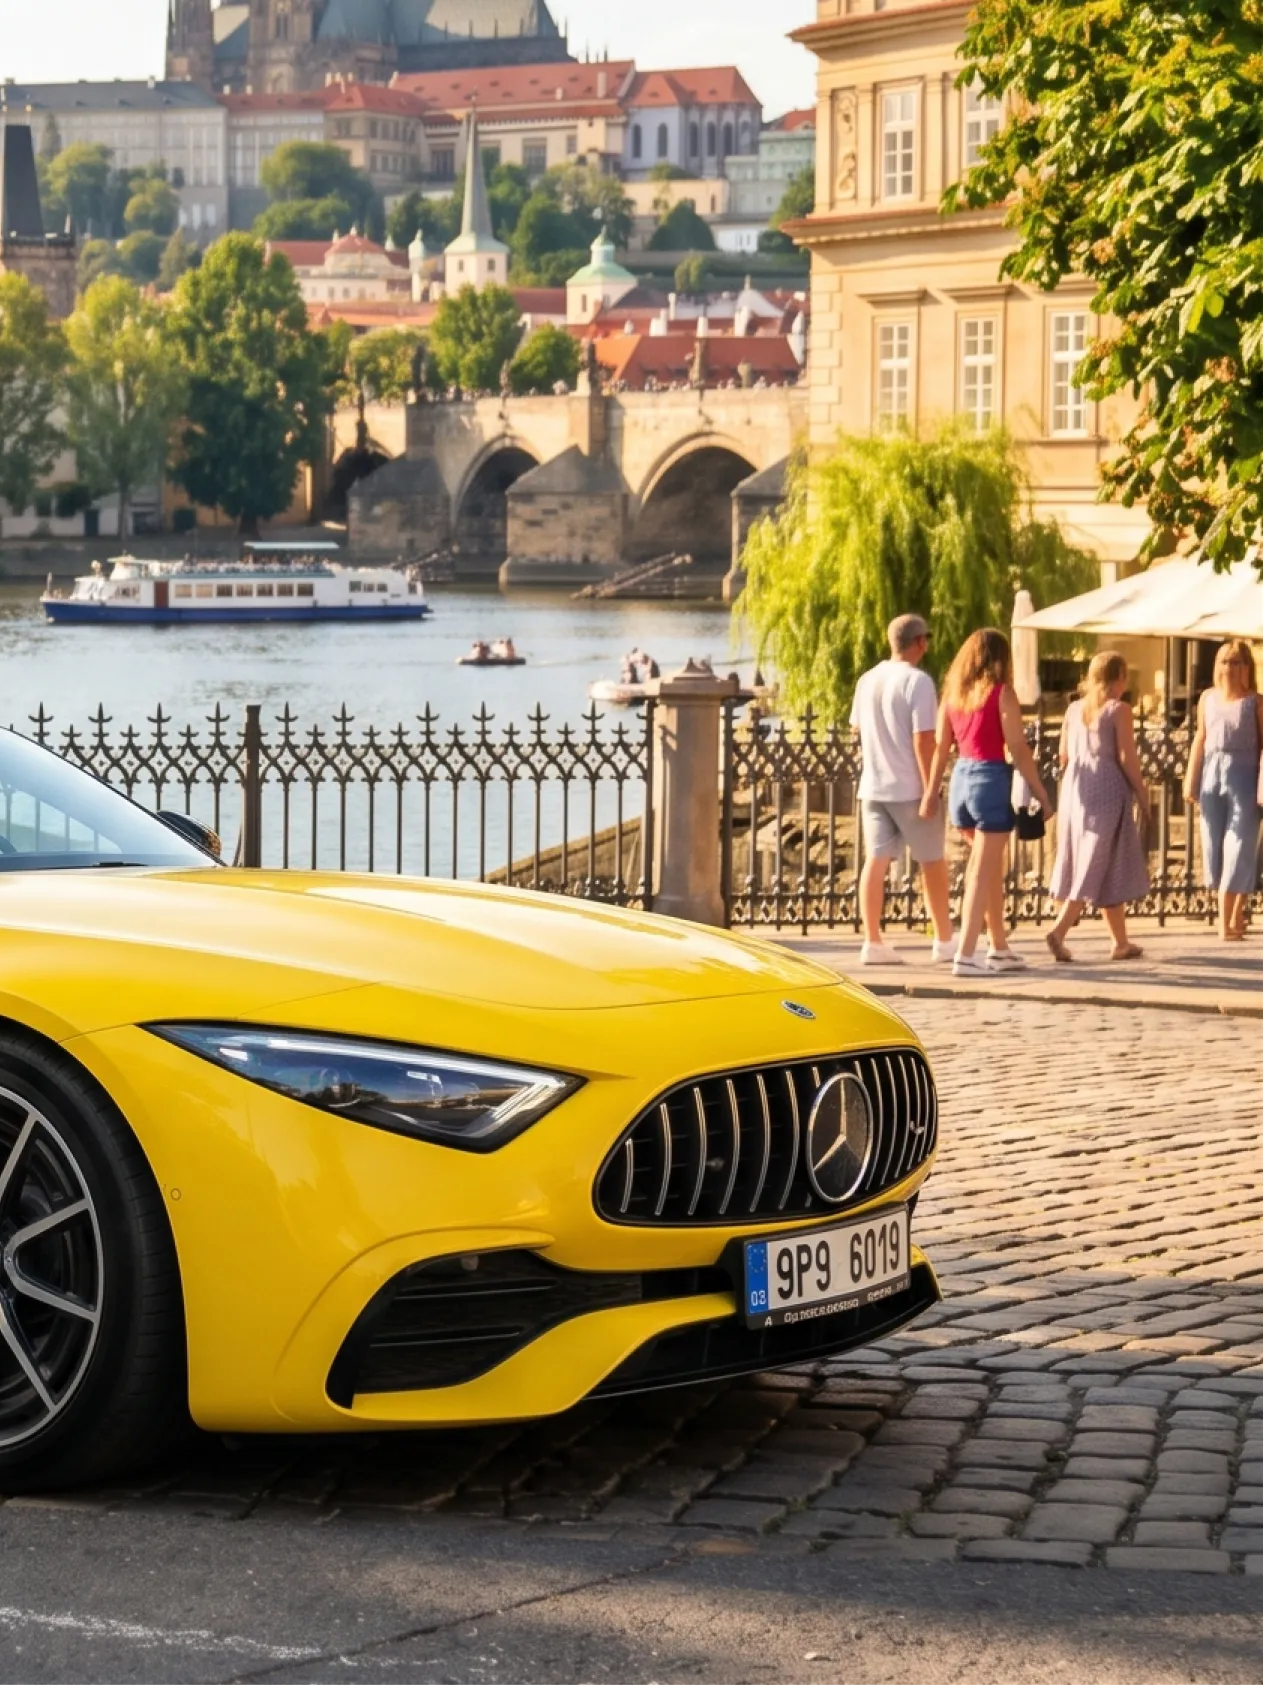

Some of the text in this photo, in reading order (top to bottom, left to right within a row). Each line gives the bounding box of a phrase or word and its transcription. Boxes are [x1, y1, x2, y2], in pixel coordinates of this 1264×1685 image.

[777, 1220, 900, 1300] 9P9 6019
[751, 1290, 767, 1306] 03
